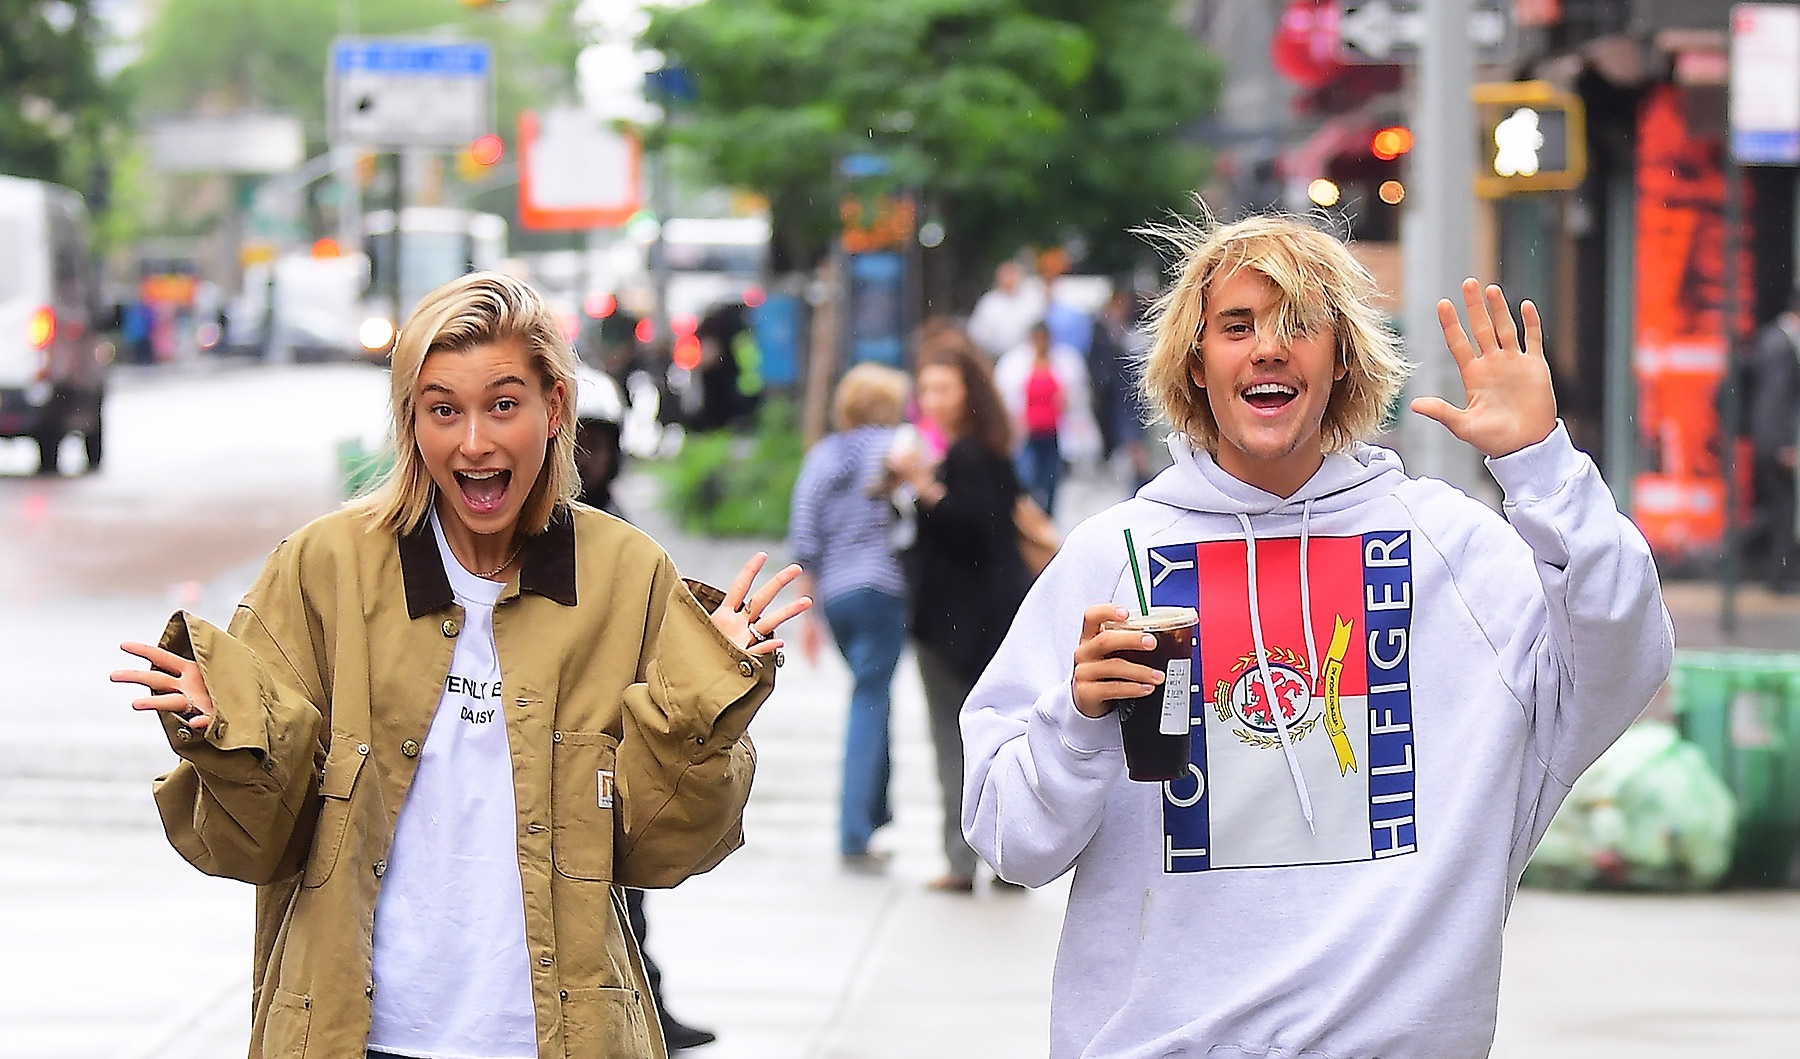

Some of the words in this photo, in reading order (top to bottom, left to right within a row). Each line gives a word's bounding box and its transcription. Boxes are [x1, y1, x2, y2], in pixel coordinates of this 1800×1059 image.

[460, 706, 495, 724] DAISY
[1150, 549, 1206, 871] TOY
[1365, 532, 1415, 858] HILFIGER
